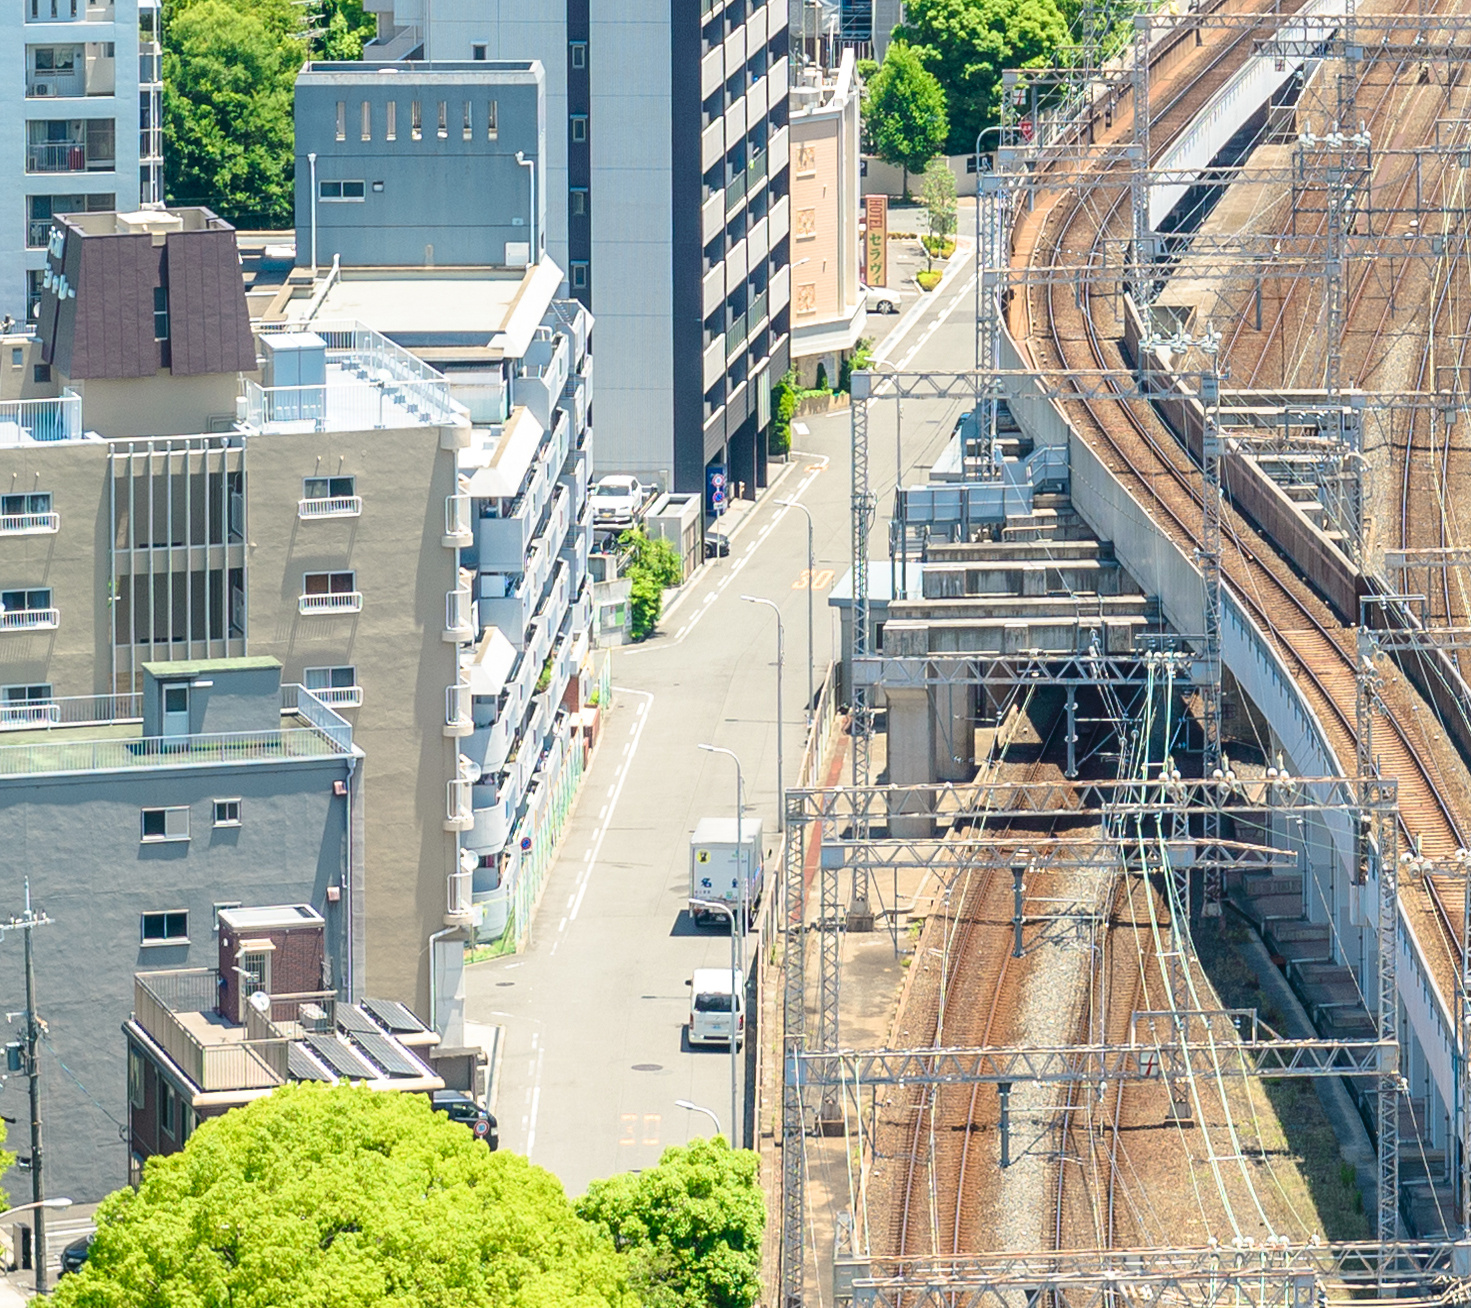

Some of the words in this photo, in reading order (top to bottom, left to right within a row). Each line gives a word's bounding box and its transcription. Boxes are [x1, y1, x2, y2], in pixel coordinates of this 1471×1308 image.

[868, 198, 884, 231] HOTEL
[869, 232, 882, 286] セラヴィ
[791, 568, 835, 591] 30
